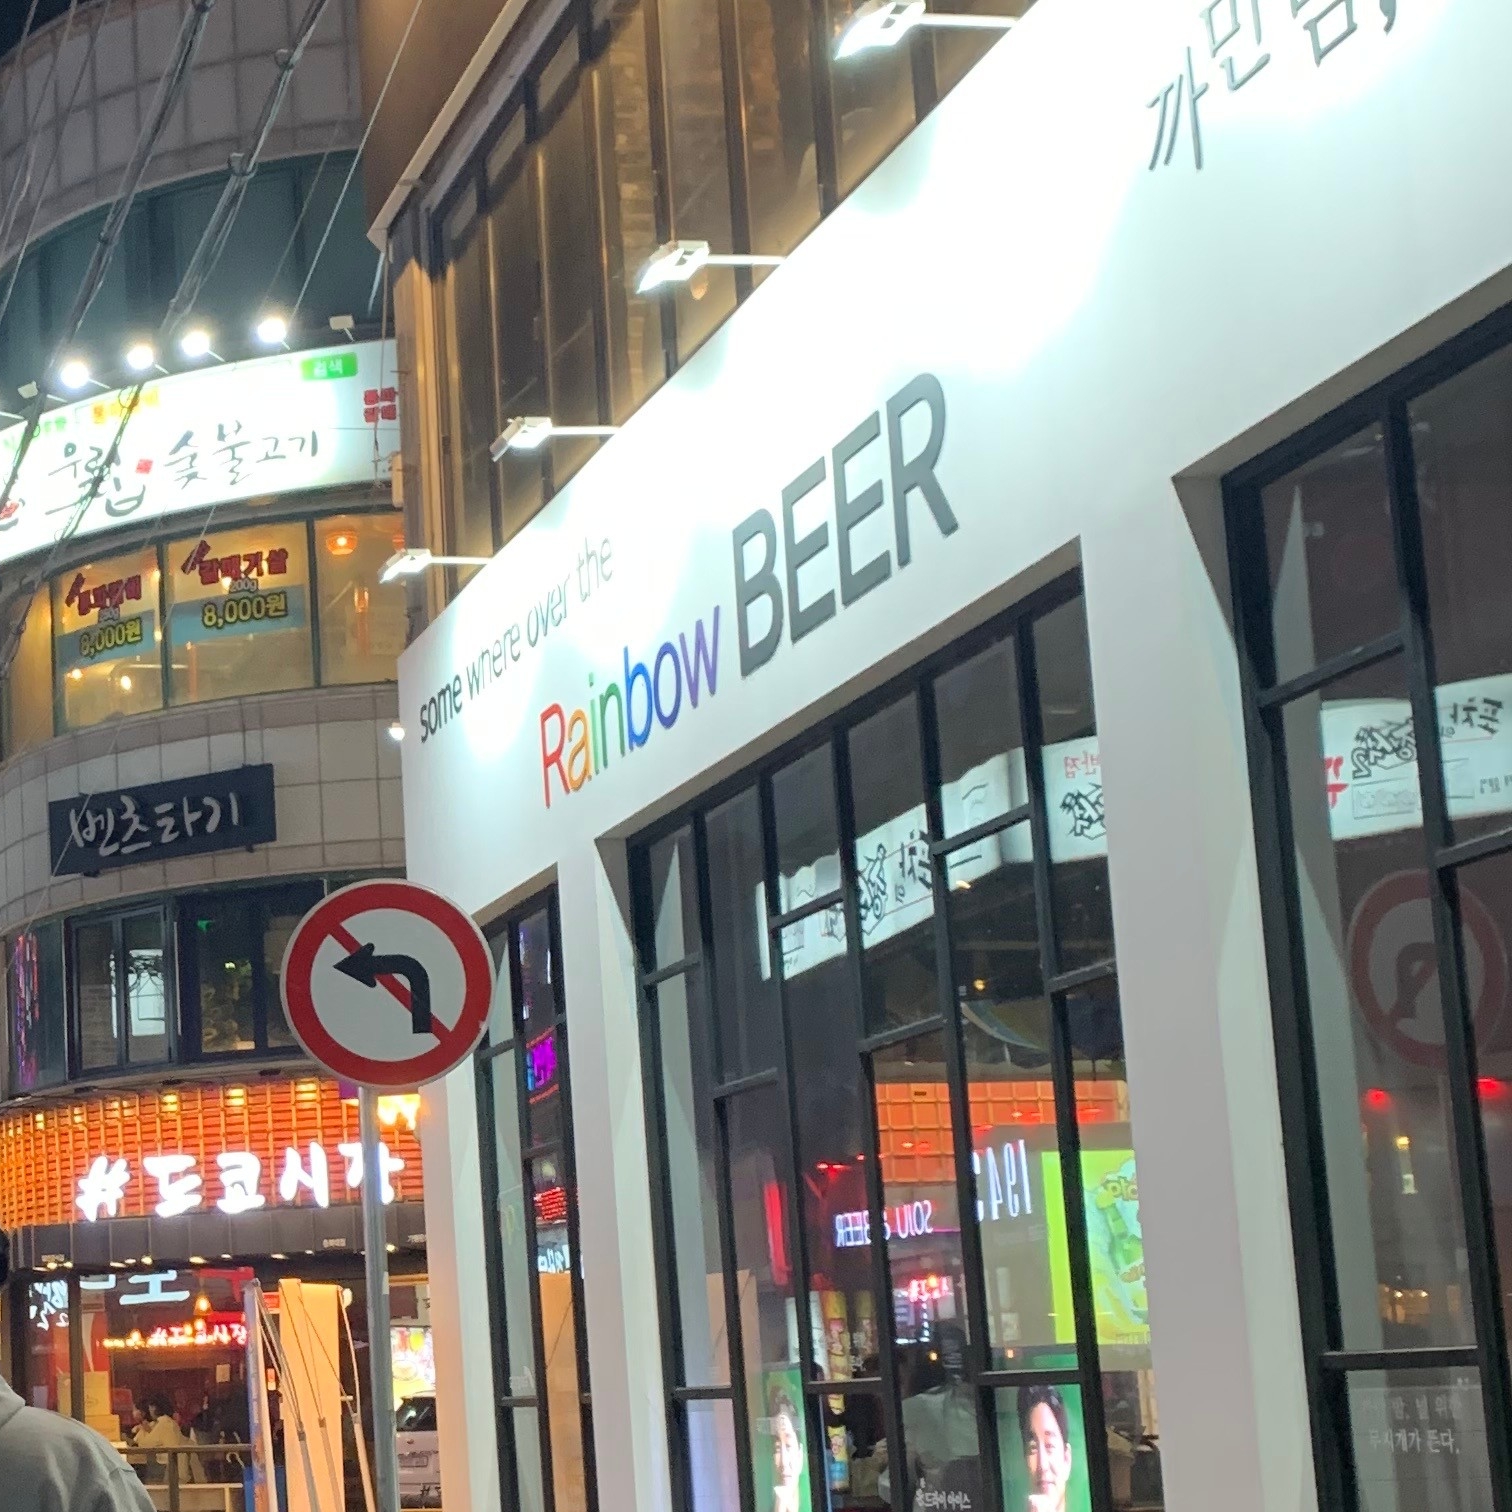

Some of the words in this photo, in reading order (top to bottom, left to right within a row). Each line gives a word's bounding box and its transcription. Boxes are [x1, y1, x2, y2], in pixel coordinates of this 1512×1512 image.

[201, 592, 289, 629] 8,000원
[538, 604, 721, 809] Rainbow
[732, 372, 960, 680] BEER
[80, 616, 143, 658] 8,000원
[419, 669, 464, 743] some
[466, 620, 521, 703] where
[527, 569, 571, 649] over
[574, 536, 614, 603] the
[68, 791, 239, 858] 벤츠타기
